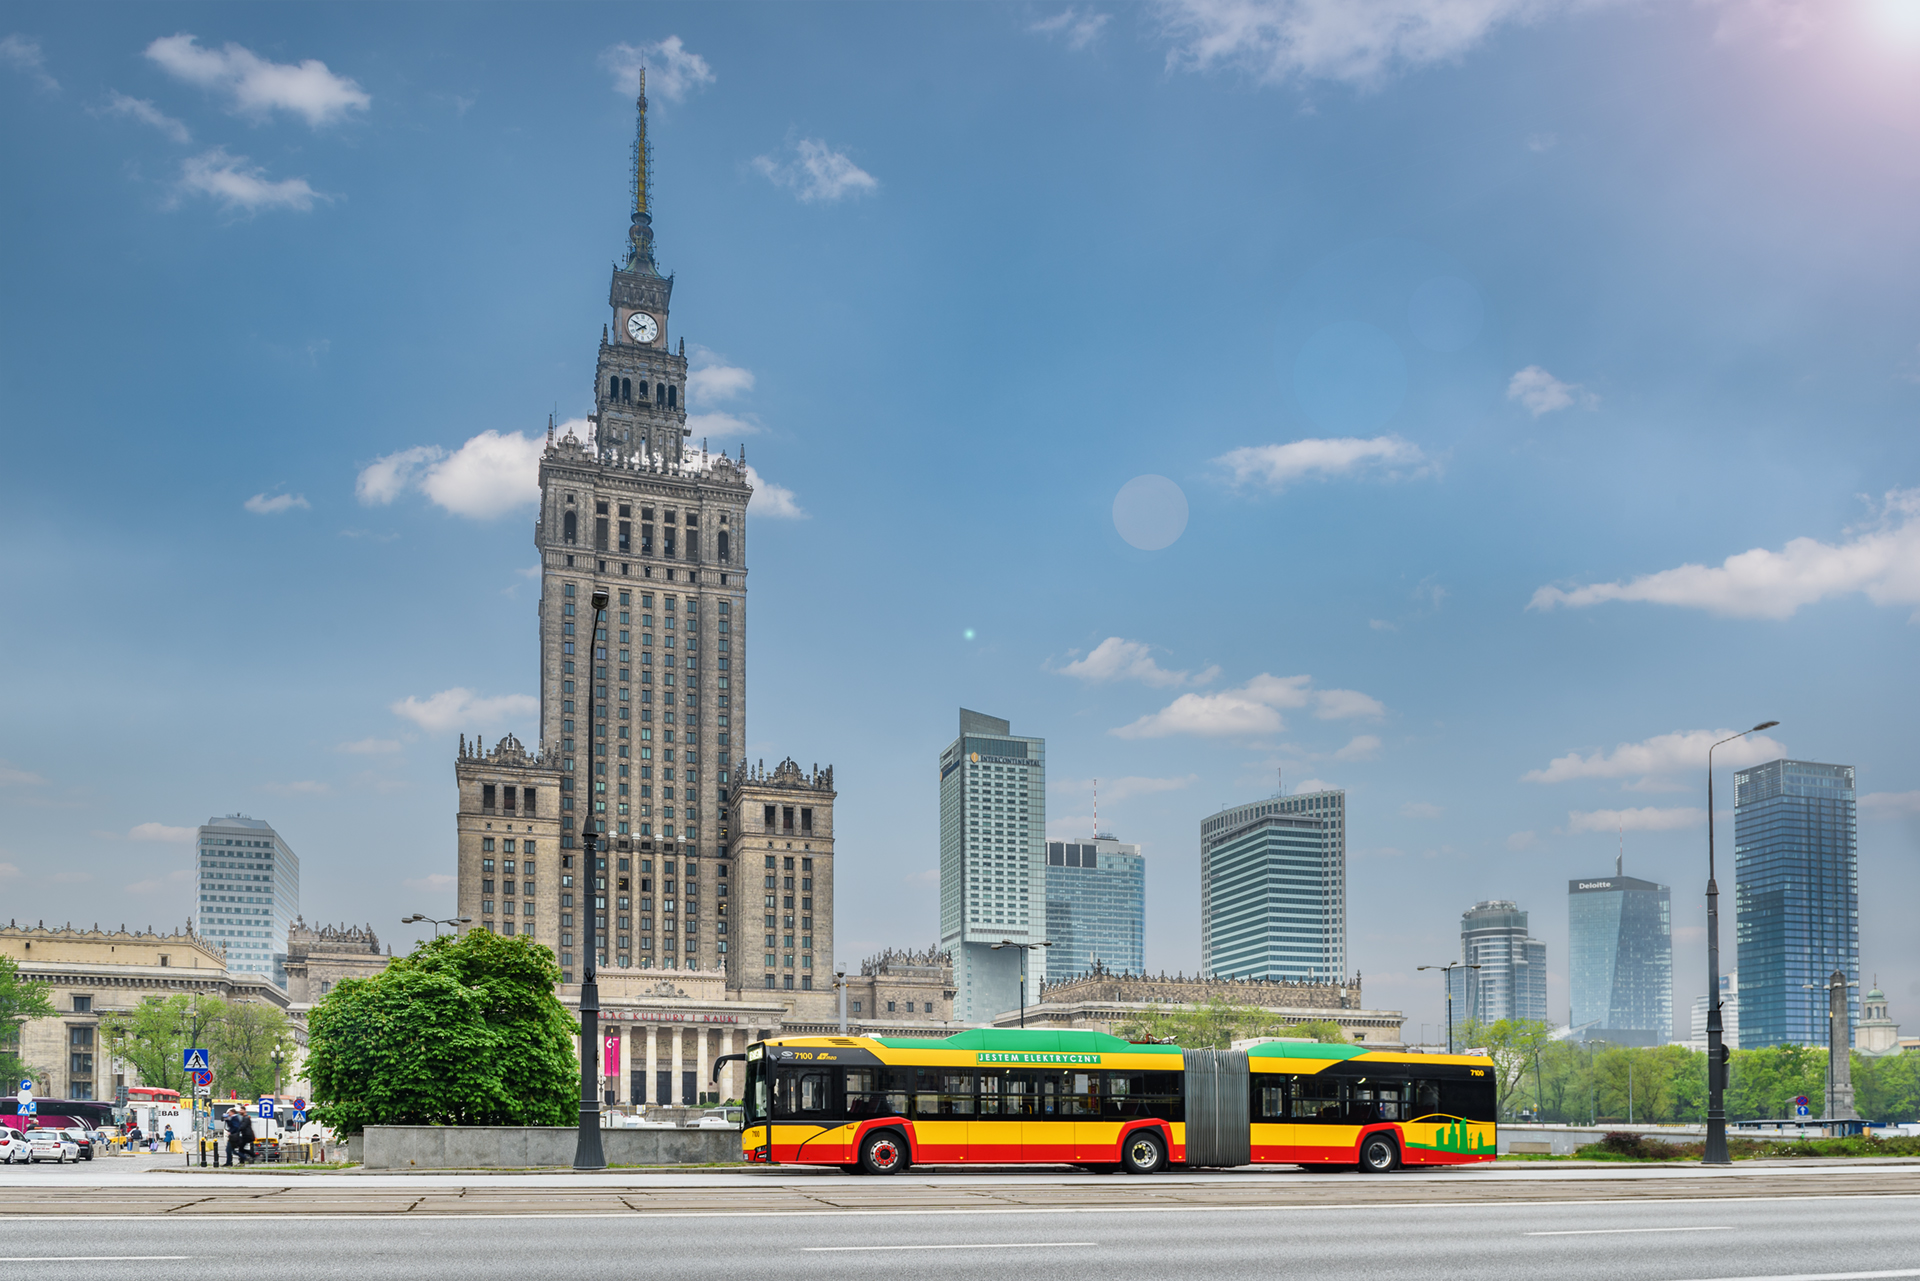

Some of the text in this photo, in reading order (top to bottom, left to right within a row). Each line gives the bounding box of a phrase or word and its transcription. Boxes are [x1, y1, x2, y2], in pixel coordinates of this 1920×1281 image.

[633, 1012, 685, 1022] KULTURY
[704, 1014, 739, 1024] NAUKI
[794, 1052, 813, 1060] 7100
[979, 1053, 1098, 1063] JESTEM ELEKTRYCZNY
[1470, 1069, 1485, 1077] 7100
